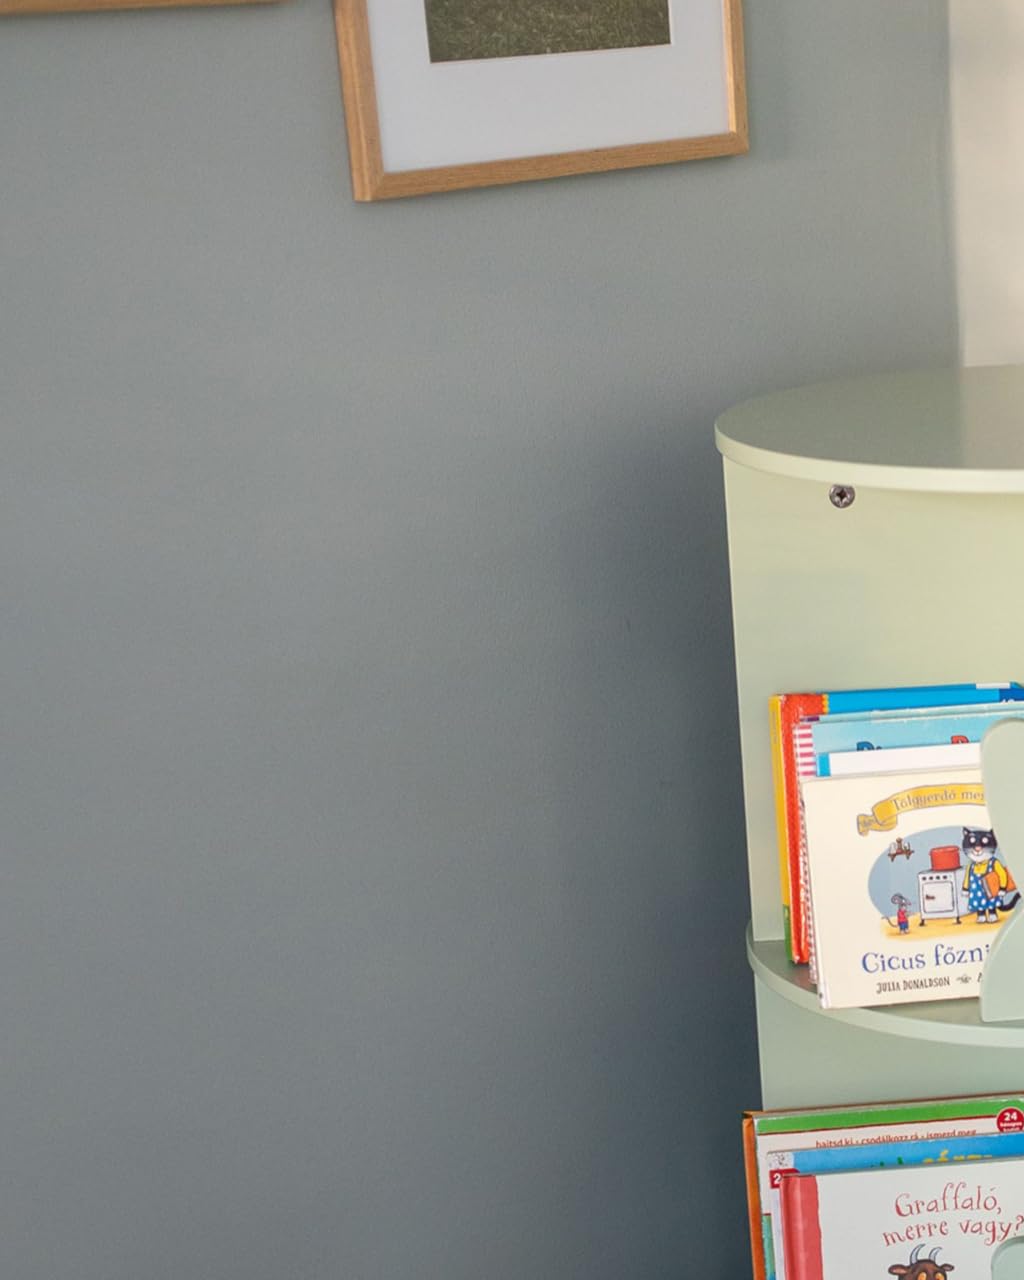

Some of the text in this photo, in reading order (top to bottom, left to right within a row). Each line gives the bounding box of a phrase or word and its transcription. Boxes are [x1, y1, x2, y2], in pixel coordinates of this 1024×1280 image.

[861, 952, 926, 974] Cicus
[876, 976, 951, 994] JULIA DONALDSON
[1003, 1111, 1018, 1122] 24
[895, 1181, 1002, 1218] Graffaló,
[882, 1215, 1024, 1247] merre vagy?
